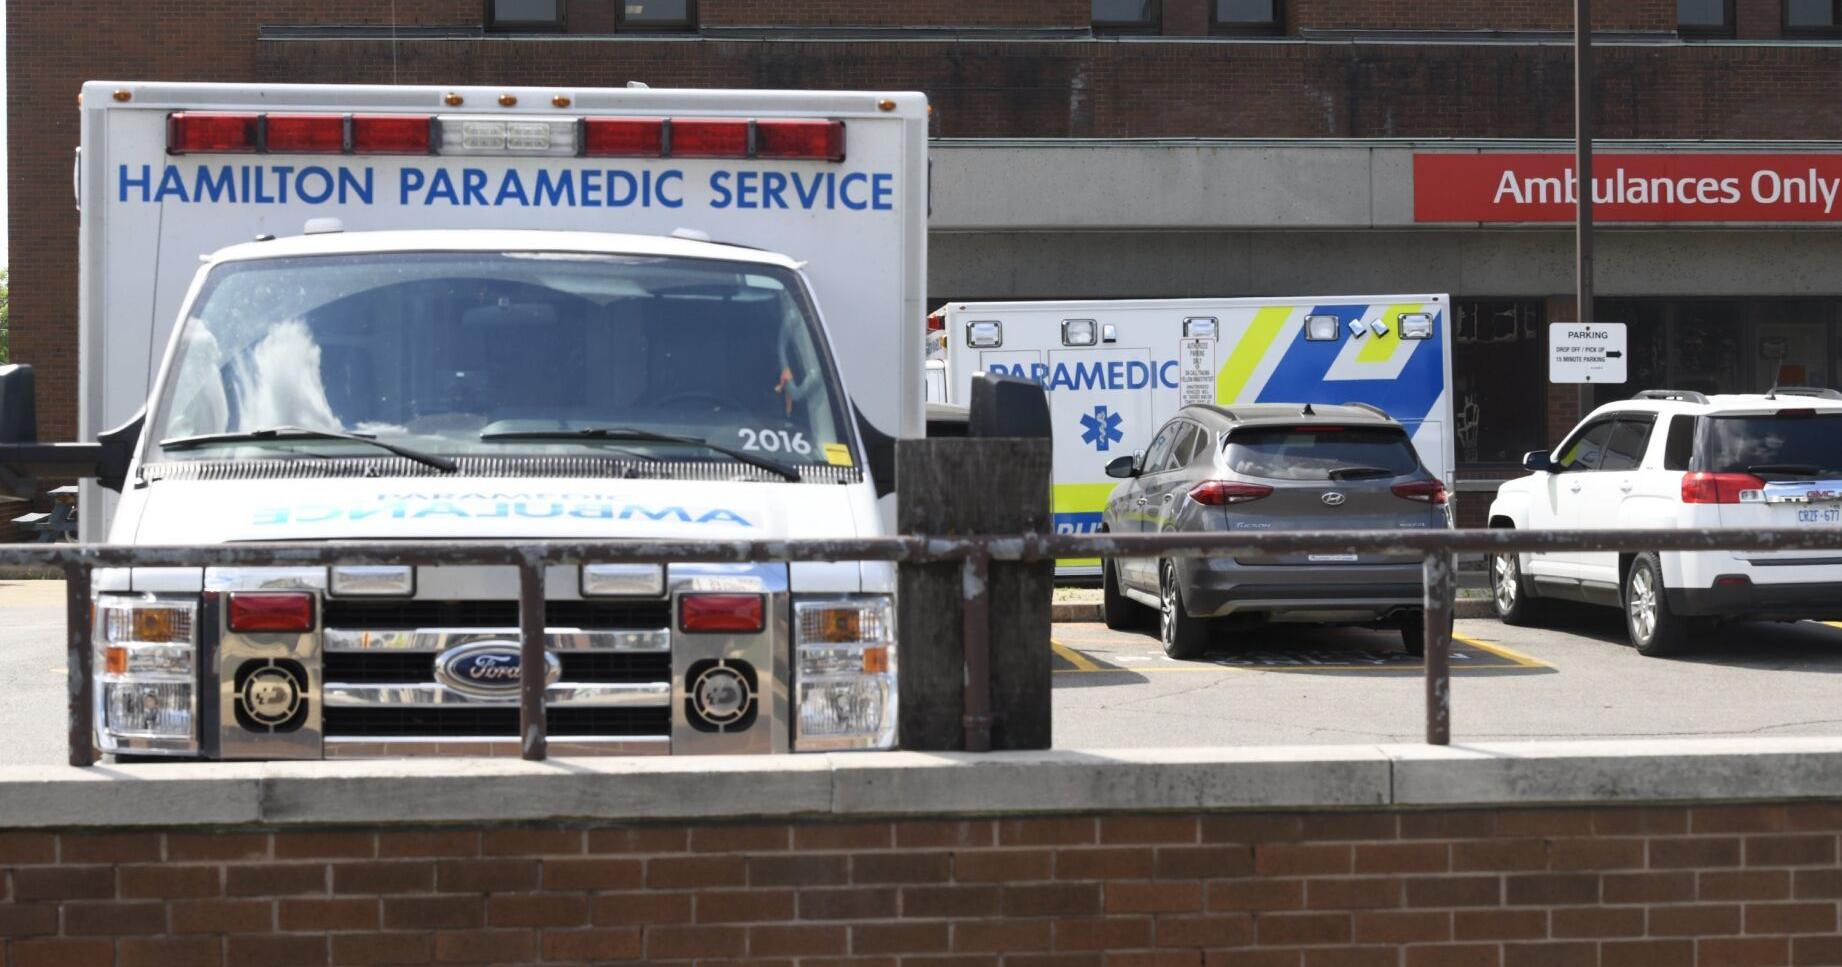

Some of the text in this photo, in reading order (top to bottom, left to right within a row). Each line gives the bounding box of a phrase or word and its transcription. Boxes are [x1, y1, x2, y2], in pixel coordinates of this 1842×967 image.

[119, 165, 893, 210] HAMILTON PARAMEDIC SERVICE
[1493, 168, 1841, 213] Ambulances Only
[1568, 331, 1608, 339] PARKING
[738, 428, 811, 455] 2016
[1807, 490, 1835, 498] GMC
